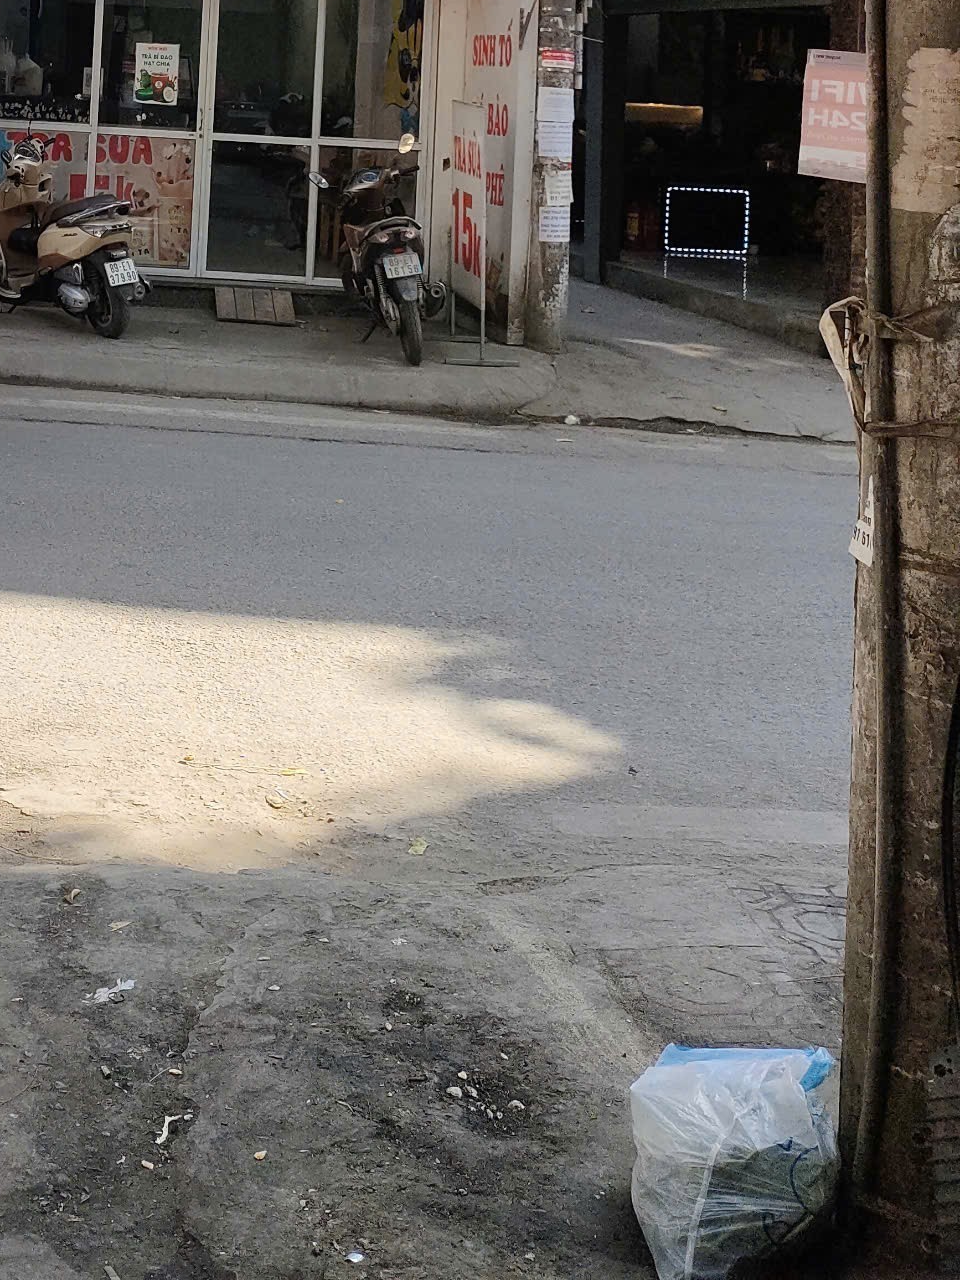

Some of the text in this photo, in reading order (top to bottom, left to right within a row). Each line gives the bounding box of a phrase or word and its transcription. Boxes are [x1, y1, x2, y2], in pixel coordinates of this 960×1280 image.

[472, 17, 513, 67] SINH TỐ
[486, 93, 509, 137] BÀO
[109, 260, 132, 274] 89-E1
